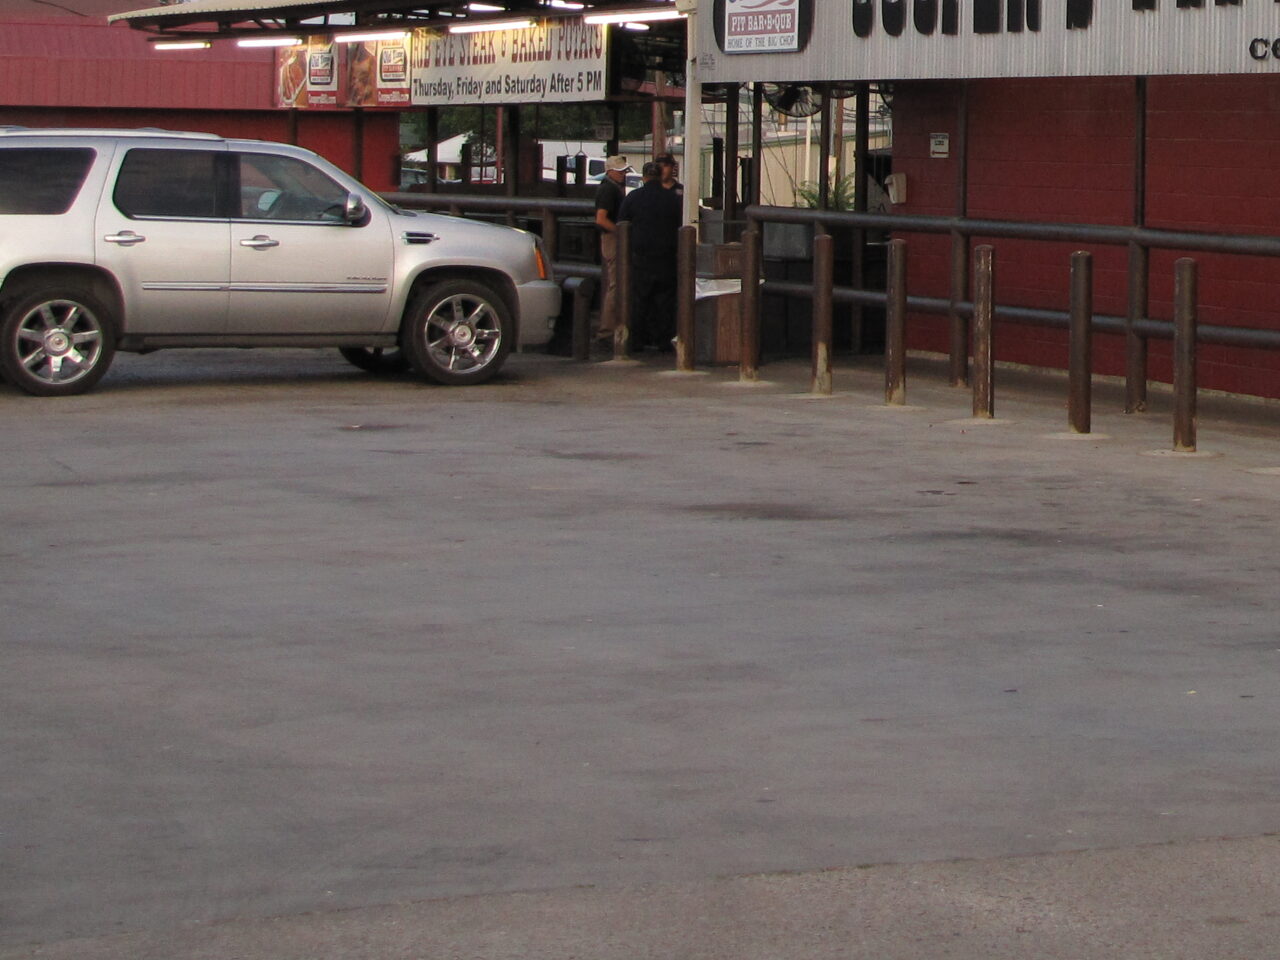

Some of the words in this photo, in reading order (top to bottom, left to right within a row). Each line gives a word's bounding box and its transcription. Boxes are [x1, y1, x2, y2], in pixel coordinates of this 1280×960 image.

[731, 17, 745, 32] PIT
[460, 30, 496, 66] STEAK
[512, 27, 552, 63] BAKED
[413, 76, 454, 100] Thursday,
[457, 76, 483, 99] Friday
[486, 75, 502, 95] and
[505, 74, 547, 98] Saturday
[550, 72, 575, 93] After
[577, 72, 584, 92] 5
[586, 70, 602, 92] PM
